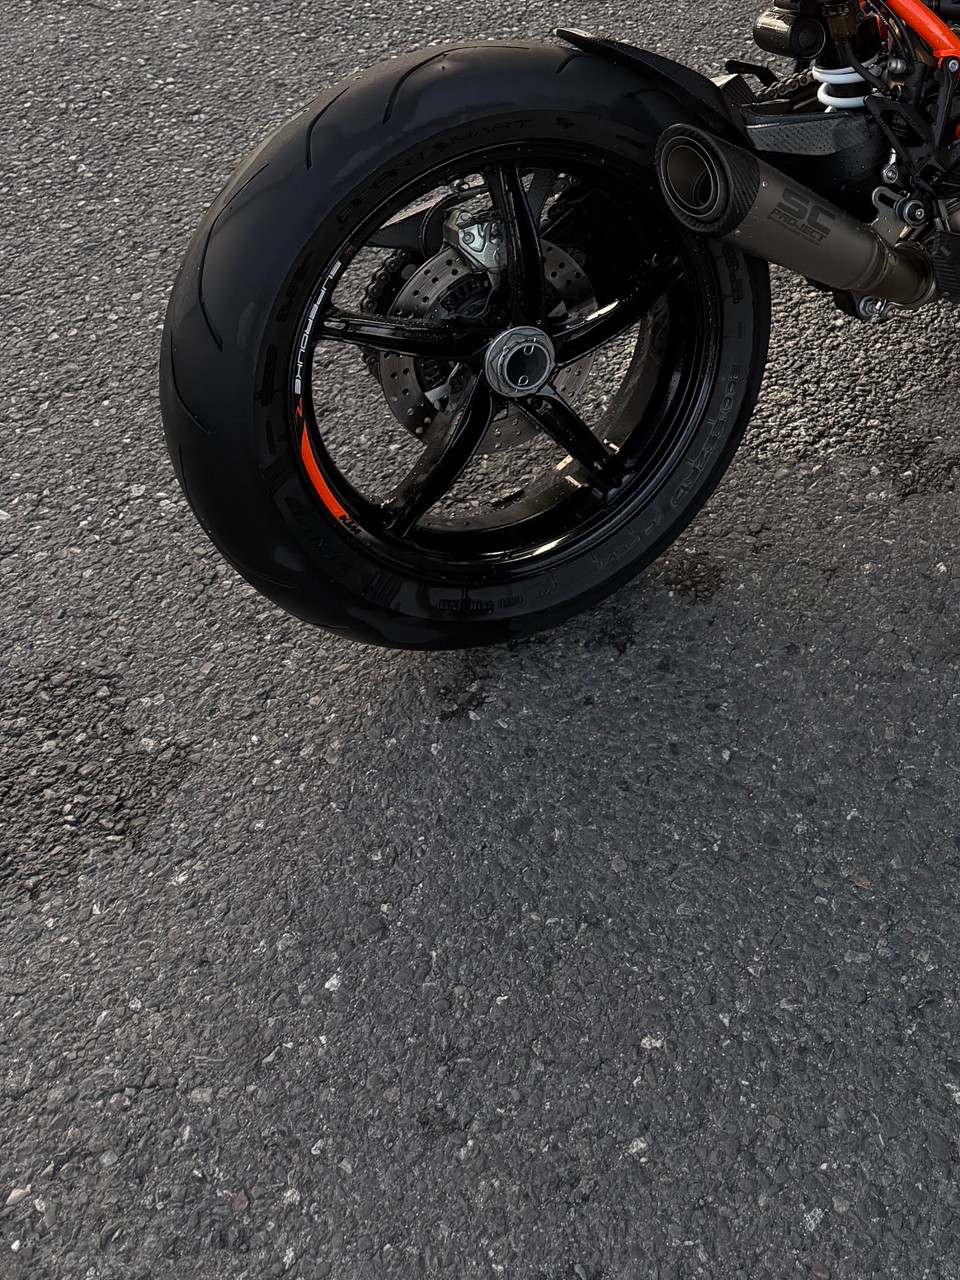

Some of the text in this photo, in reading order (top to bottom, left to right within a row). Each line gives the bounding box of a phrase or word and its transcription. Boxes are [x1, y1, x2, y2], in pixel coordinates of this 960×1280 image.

[770, 207, 827, 241] PROJECT
[776, 187, 836, 235] SC
[338, 514, 362, 534] KTM
